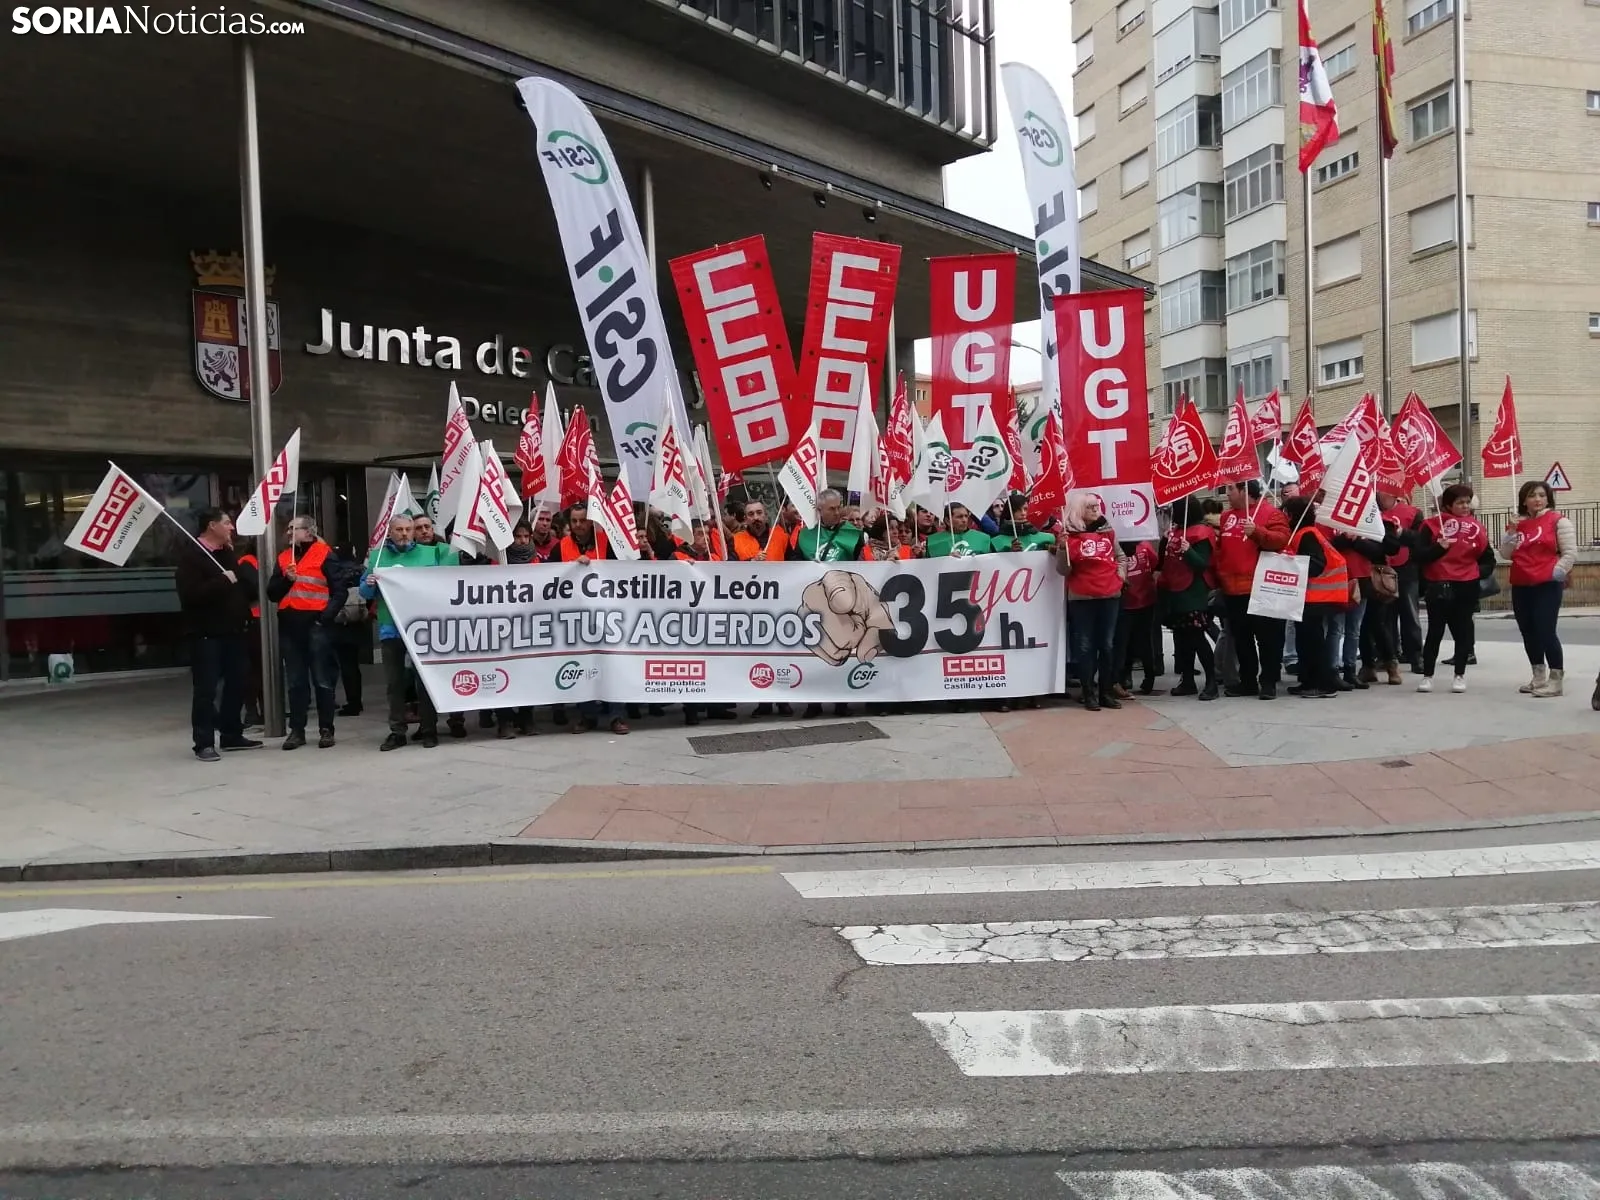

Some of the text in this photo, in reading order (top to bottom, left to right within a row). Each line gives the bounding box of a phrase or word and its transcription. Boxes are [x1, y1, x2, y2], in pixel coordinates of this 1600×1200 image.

[306, 308, 461, 370] Junta
[475, 334, 533, 378] de
[952, 269, 997, 444] UGT
[1079, 305, 1129, 480] UGT
[1170, 425, 1198, 468] UGT
[1163, 470, 1212, 495] www.ugt.es
[86, 480, 134, 545] CCOO
[1111, 501, 1135, 509] Castilla
[1266, 572, 1297, 584] CCOO
[450, 572, 779, 608] Junta de Castilla y León
[878, 567, 1045, 658] 35 ya
[406, 610, 822, 655] CUMPLE TUS ACUERDOS
[649, 663, 703, 676] CCOO
[776, 668, 791, 677] ESP
[947, 658, 1001, 672] CCOO
[561, 669, 585, 681] CSIF
[669, 680, 706, 688] pública
[853, 670, 879, 681] CSIF
[943, 674, 1006, 684] área pública
